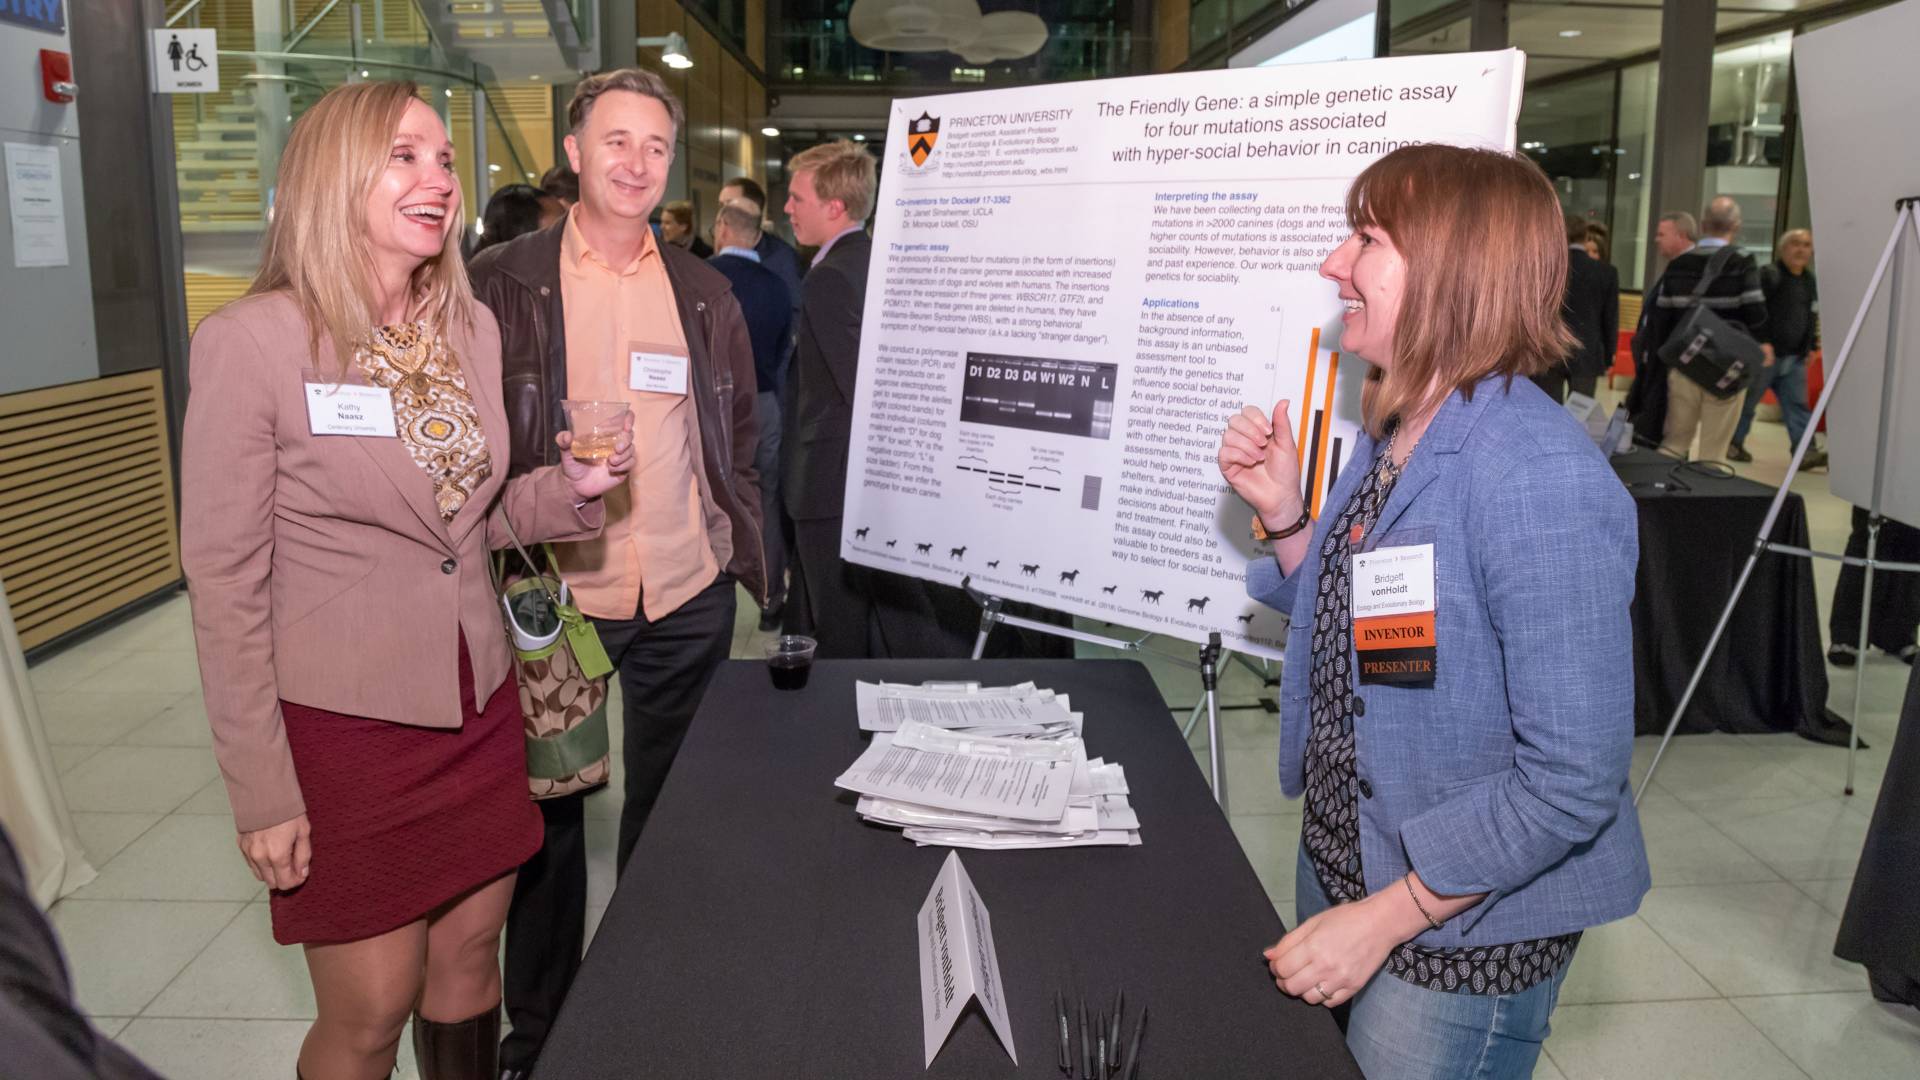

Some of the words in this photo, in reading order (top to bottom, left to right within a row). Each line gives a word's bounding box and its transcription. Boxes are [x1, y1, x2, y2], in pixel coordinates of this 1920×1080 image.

[1098, 102, 1124, 117] The
[1129, 98, 1189, 116] Friendly
[1194, 97, 1242, 111] Gene:
[1248, 98, 1258, 108] a
[1264, 92, 1319, 110] simple
[1325, 86, 1393, 108] genetic
[1399, 84, 1457, 102] assay
[949, 115, 1006, 127] PRINCETON
[1009, 110, 1072, 124] UNIVERSITY
[1144, 123, 1162, 137] for
[1168, 122, 1197, 136] four
[1203, 119, 1283, 135] mutations
[1288, 113, 1384, 132] associated
[1113, 147, 1141, 161] with
[1146, 144, 1240, 164] hyper-social
[1246, 142, 1318, 157] behavior
[1325, 141, 1340, 155] in
[1155, 191, 1208, 203] Interpreting
[1211, 190, 1226, 200] the
[1229, 193, 1257, 202] assay
[1155, 204, 1167, 214] We
[1169, 204, 1191, 214] have
[1193, 204, 1216, 214] been
[1218, 204, 1261, 217] collecting
[1263, 204, 1284, 214] data
[1302, 204, 1318, 214] the
[1152, 218, 1193, 228] mutations
[1195, 218, 1204, 228] in
[1206, 218, 1235, 228] >2000
[1236, 218, 1273, 228] canines
[1276, 218, 1303, 230] (dogs
[1306, 218, 1325, 228] and
[1150, 231, 1176, 243] higher
[1178, 231, 1208, 241] counts
[1210, 231, 1219, 241] of
[1221, 232, 1266, 242] mutations
[1269, 232, 1277, 242] is
[1280, 232, 1333, 242] associated
[904, 243, 927, 253] genetic
[929, 245, 949, 253] assay
[1149, 244, 1192, 257] sociability.
[1193, 245, 1237, 256] However,
[1238, 246, 1278, 256] behavior
[1282, 246, 1290, 256] is
[1293, 246, 1313, 256] also
[1147, 257, 1163, 267] and
[1164, 258, 1183, 270] past
[1185, 259, 1237, 271] experience.
[1239, 260, 1257, 269] Our
[1260, 260, 1283, 270] work
[1146, 271, 1180, 283] genetics
[1182, 271, 1194, 281] for
[1142, 297, 1199, 310] Applications
[1141, 310, 1148, 320] In
[1150, 310, 1164, 321] the
[1166, 312, 1203, 322] absence
[1205, 313, 1215, 323] of
[1217, 316, 1233, 327] any
[1139, 323, 1188, 336] background
[1190, 326, 1244, 340] information,
[1138, 336, 1152, 347] this
[1154, 340, 1179, 351] assay
[1181, 339, 1189, 349] is
[1205, 341, 1247, 353] unbiased
[1136, 352, 1186, 362] assessment
[1188, 353, 1205, 364] tool
[1207, 354, 1216, 364] to
[969, 366, 982, 377] D1
[987, 367, 1000, 378] D2
[1005, 369, 1019, 380] D3
[1023, 370, 1037, 382] D4
[1040, 372, 1055, 384] W1
[1058, 373, 1075, 386] W2
[1081, 376, 1090, 387] N
[1101, 378, 1109, 389] L
[1134, 364, 1166, 378] quantify
[1169, 366, 1182, 376] the
[1185, 369, 1223, 380] genetics
[1225, 370, 1243, 381] that
[1132, 376, 1170, 388] influence
[1172, 380, 1198, 391] social
[1200, 382, 1241, 394] behavior.
[338, 403, 360, 411] Kathy
[1131, 389, 1142, 399] An
[1144, 391, 1165, 404] early
[1167, 394, 1205, 405] predictor
[1208, 397, 1217, 406] of
[1220, 398, 1242, 409] adult
[1126, 430, 1142, 440] with
[1144, 432, 1166, 443] other
[1168, 434, 1214, 449] behavioral
[1123, 457, 1148, 467] would
[1149, 458, 1168, 473] help
[1169, 464, 1204, 476] owners,
[1120, 483, 1142, 494] make
[1144, 485, 1215, 505] individual-based
[1118, 495, 1156, 510] decisions
[1159, 502, 1183, 514] about
[1185, 505, 1213, 518] health
[1117, 510, 1132, 519] and
[1134, 511, 1177, 527] treatment.
[1179, 518, 1210, 534] Finally,
[1115, 521, 1129, 532] this
[1131, 526, 1156, 539] assay
[1158, 531, 1182, 542] could
[1184, 534, 1203, 545] also
[1205, 537, 1217, 548] be
[1114, 536, 1147, 549] valuable
[1149, 541, 1158, 551] to
[1160, 543, 1199, 558] breeders
[1202, 553, 1213, 561] as
[1112, 550, 1128, 561] way
[1130, 550, 1138, 561] to
[1140, 554, 1165, 566] select
[1167, 558, 1179, 569] for
[1181, 563, 1208, 574] social
[1374, 572, 1404, 584] Bridgett
[1372, 585, 1408, 596] vonHoldt
[1364, 627, 1424, 641] INVENTOR
[1364, 660, 1431, 674] PRESENTER
